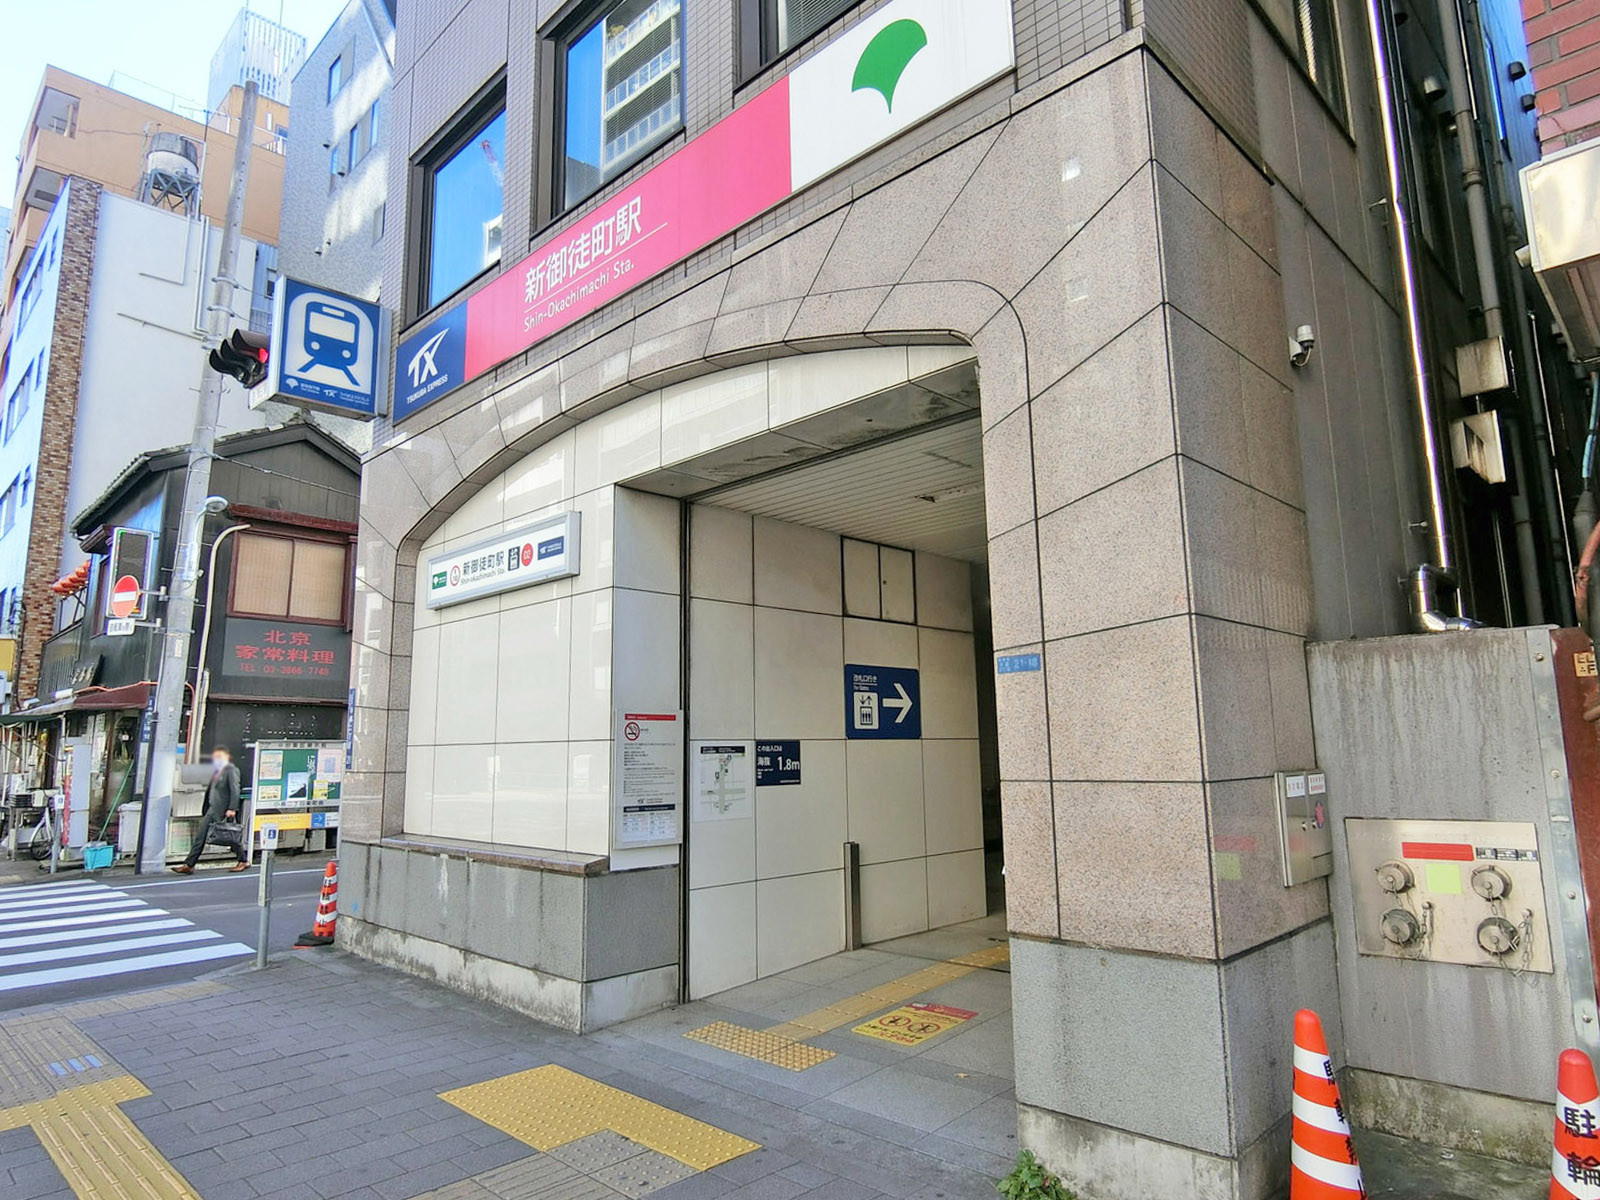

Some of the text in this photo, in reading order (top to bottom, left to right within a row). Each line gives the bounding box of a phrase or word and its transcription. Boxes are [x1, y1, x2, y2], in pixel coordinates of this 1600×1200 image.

[524, 195, 642, 304] 新御徒町駅
[524, 258, 635, 333] Shin-Okachimachi Sta.
[407, 327, 450, 388] TX
[427, 374, 449, 393] EXPRESS
[463, 550, 505, 576] 新御徒町駅
[263, 629, 313, 646] 北京
[235, 644, 335, 665] 家常料理
[757, 756, 771, 767] 海抜
[777, 756, 801, 771] 1.8m
